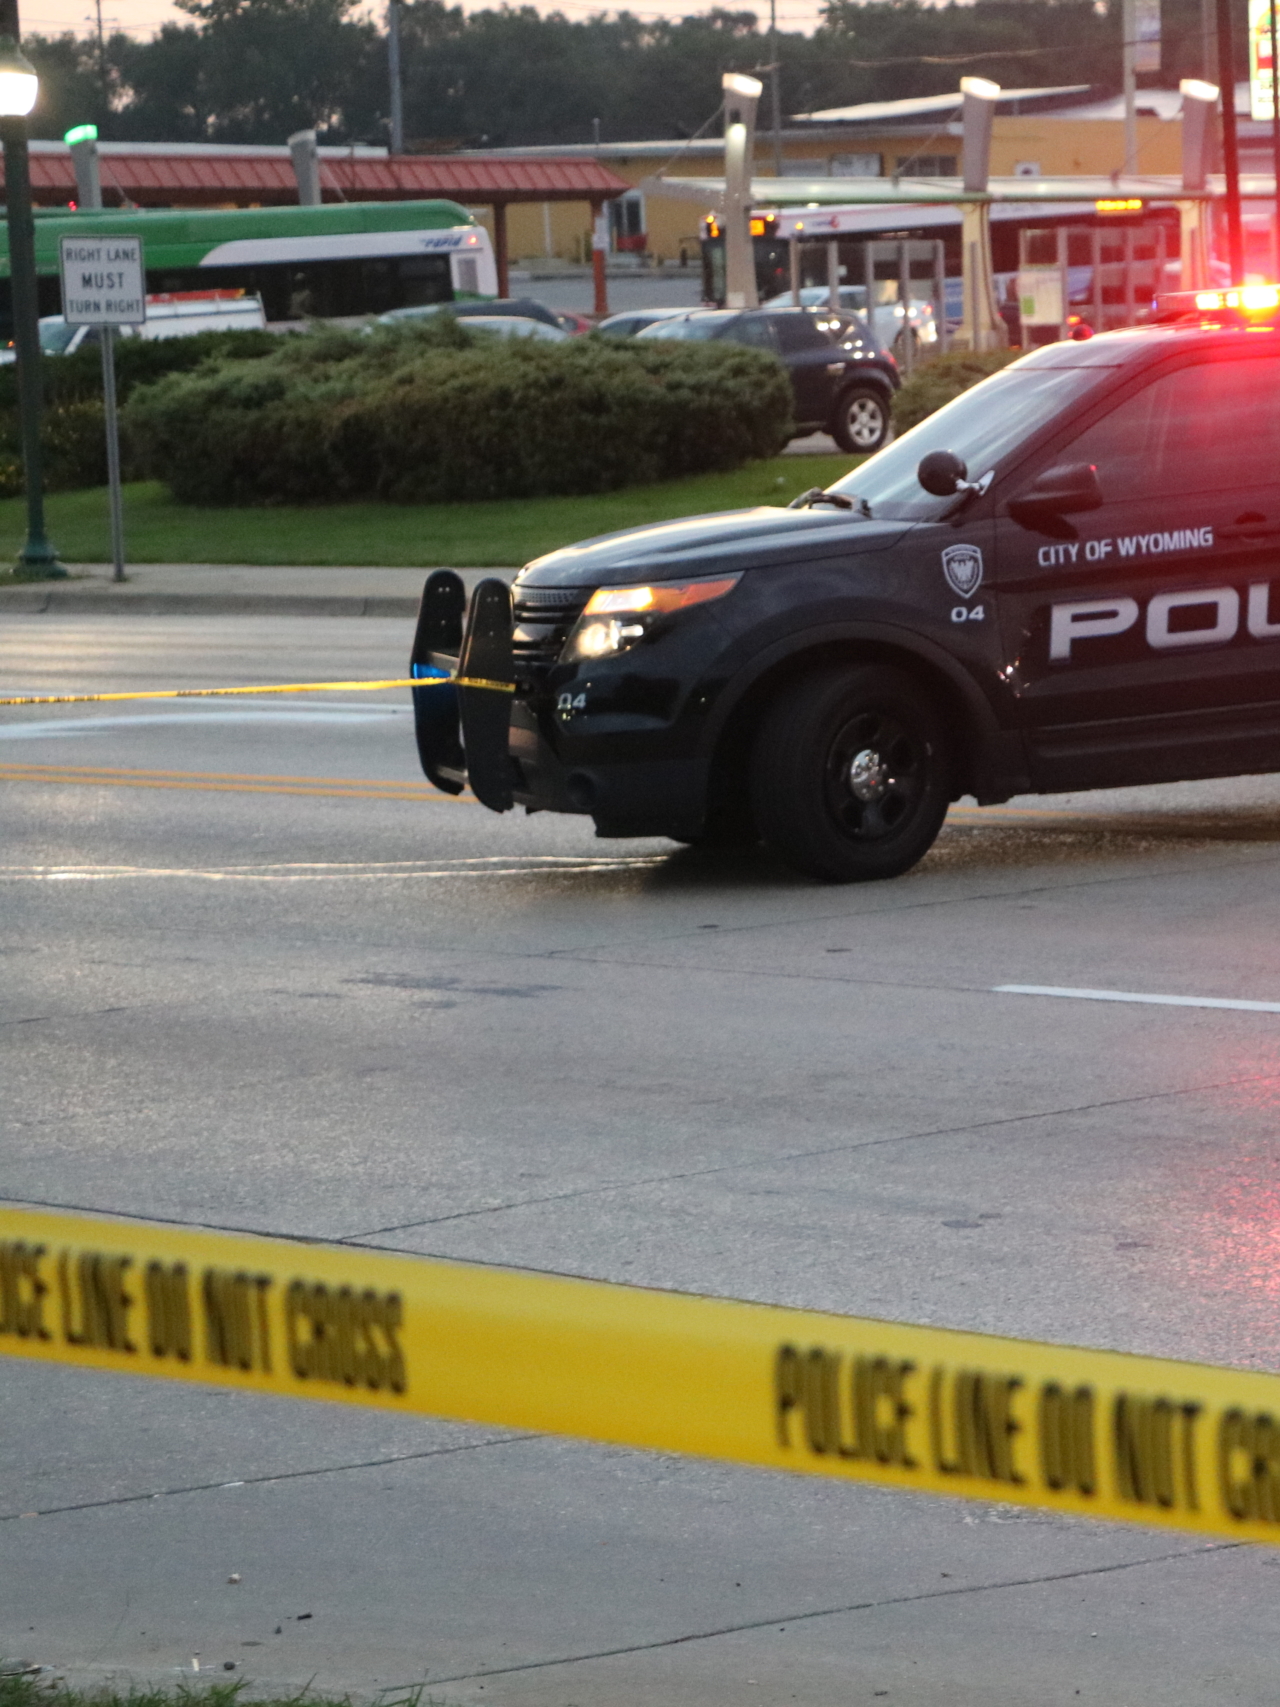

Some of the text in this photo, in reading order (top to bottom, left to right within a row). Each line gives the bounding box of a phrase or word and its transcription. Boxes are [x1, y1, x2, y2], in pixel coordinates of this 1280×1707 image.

[65, 247, 138, 261] RIGHT LANE
[82, 271, 124, 289] MUST
[69, 299, 140, 313] TURN RIGHT
[1038, 526, 1213, 567] CITY OF WYOMING
[951, 604, 985, 622] 04
[58, 1247, 137, 1354] LINE
[201, 1265, 274, 1376] NOT
[285, 1275, 410, 1398] CROSS
[774, 1342, 918, 1472] POLICE
[929, 1361, 1026, 1487] LINE
[1111, 1391, 1203, 1513] NOT
